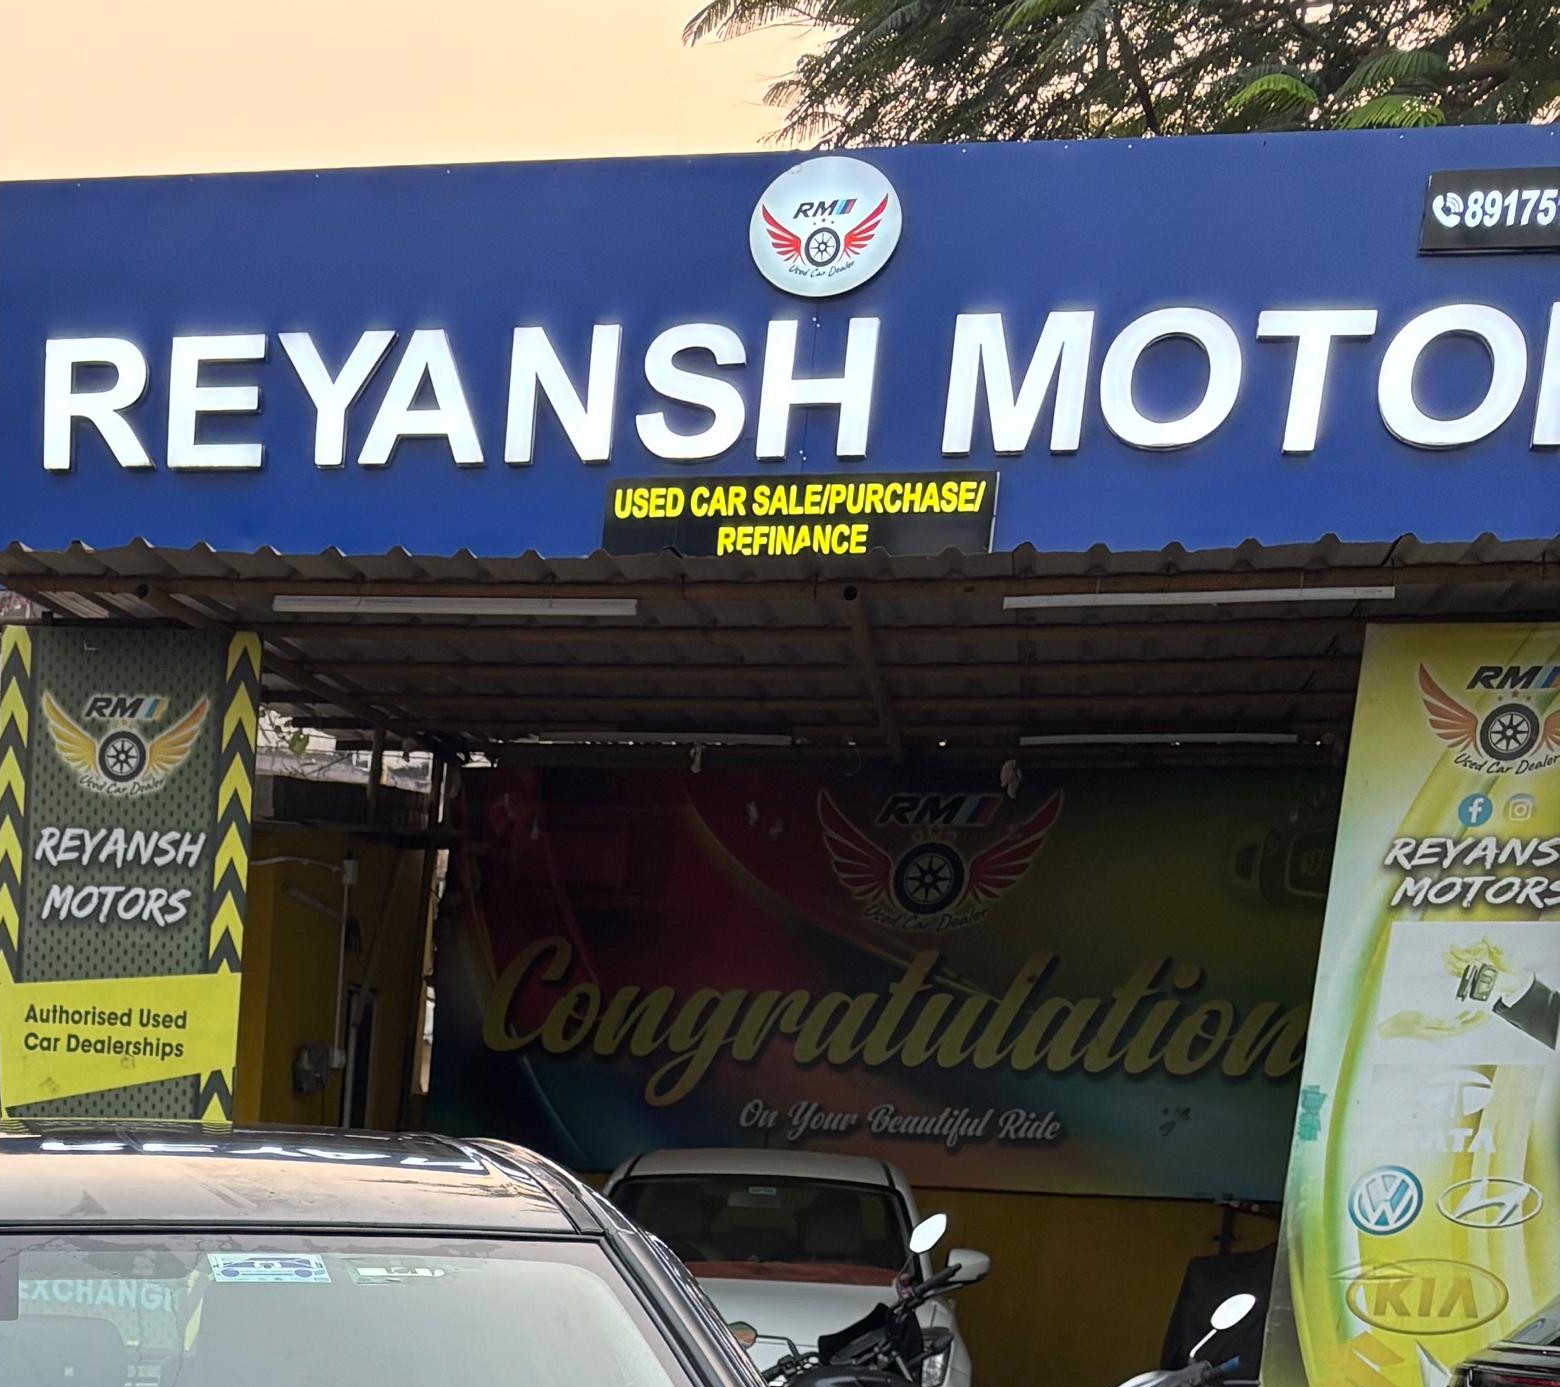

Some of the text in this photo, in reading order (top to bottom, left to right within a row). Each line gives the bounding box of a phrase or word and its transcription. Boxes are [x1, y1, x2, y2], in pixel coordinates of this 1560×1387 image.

[1464, 189, 1560, 228] 89175
[43, 303, 1560, 471] REYANSH MOTO
[614, 480, 986, 519] USED CAR SALE/PURCHASE/
[716, 523, 869, 556] REFINANCE
[1454, 753, 1560, 775] Used Car Dealer
[34, 827, 207, 868] REYANSH
[41, 884, 192, 927] MOTORS
[24, 1004, 187, 1030] Authorised Used
[24, 1032, 184, 1061] Car Dealerships
[740, 1099, 1061, 1147] On Your Beautiful Ride
[1374, 1277, 1479, 1318] KIA
